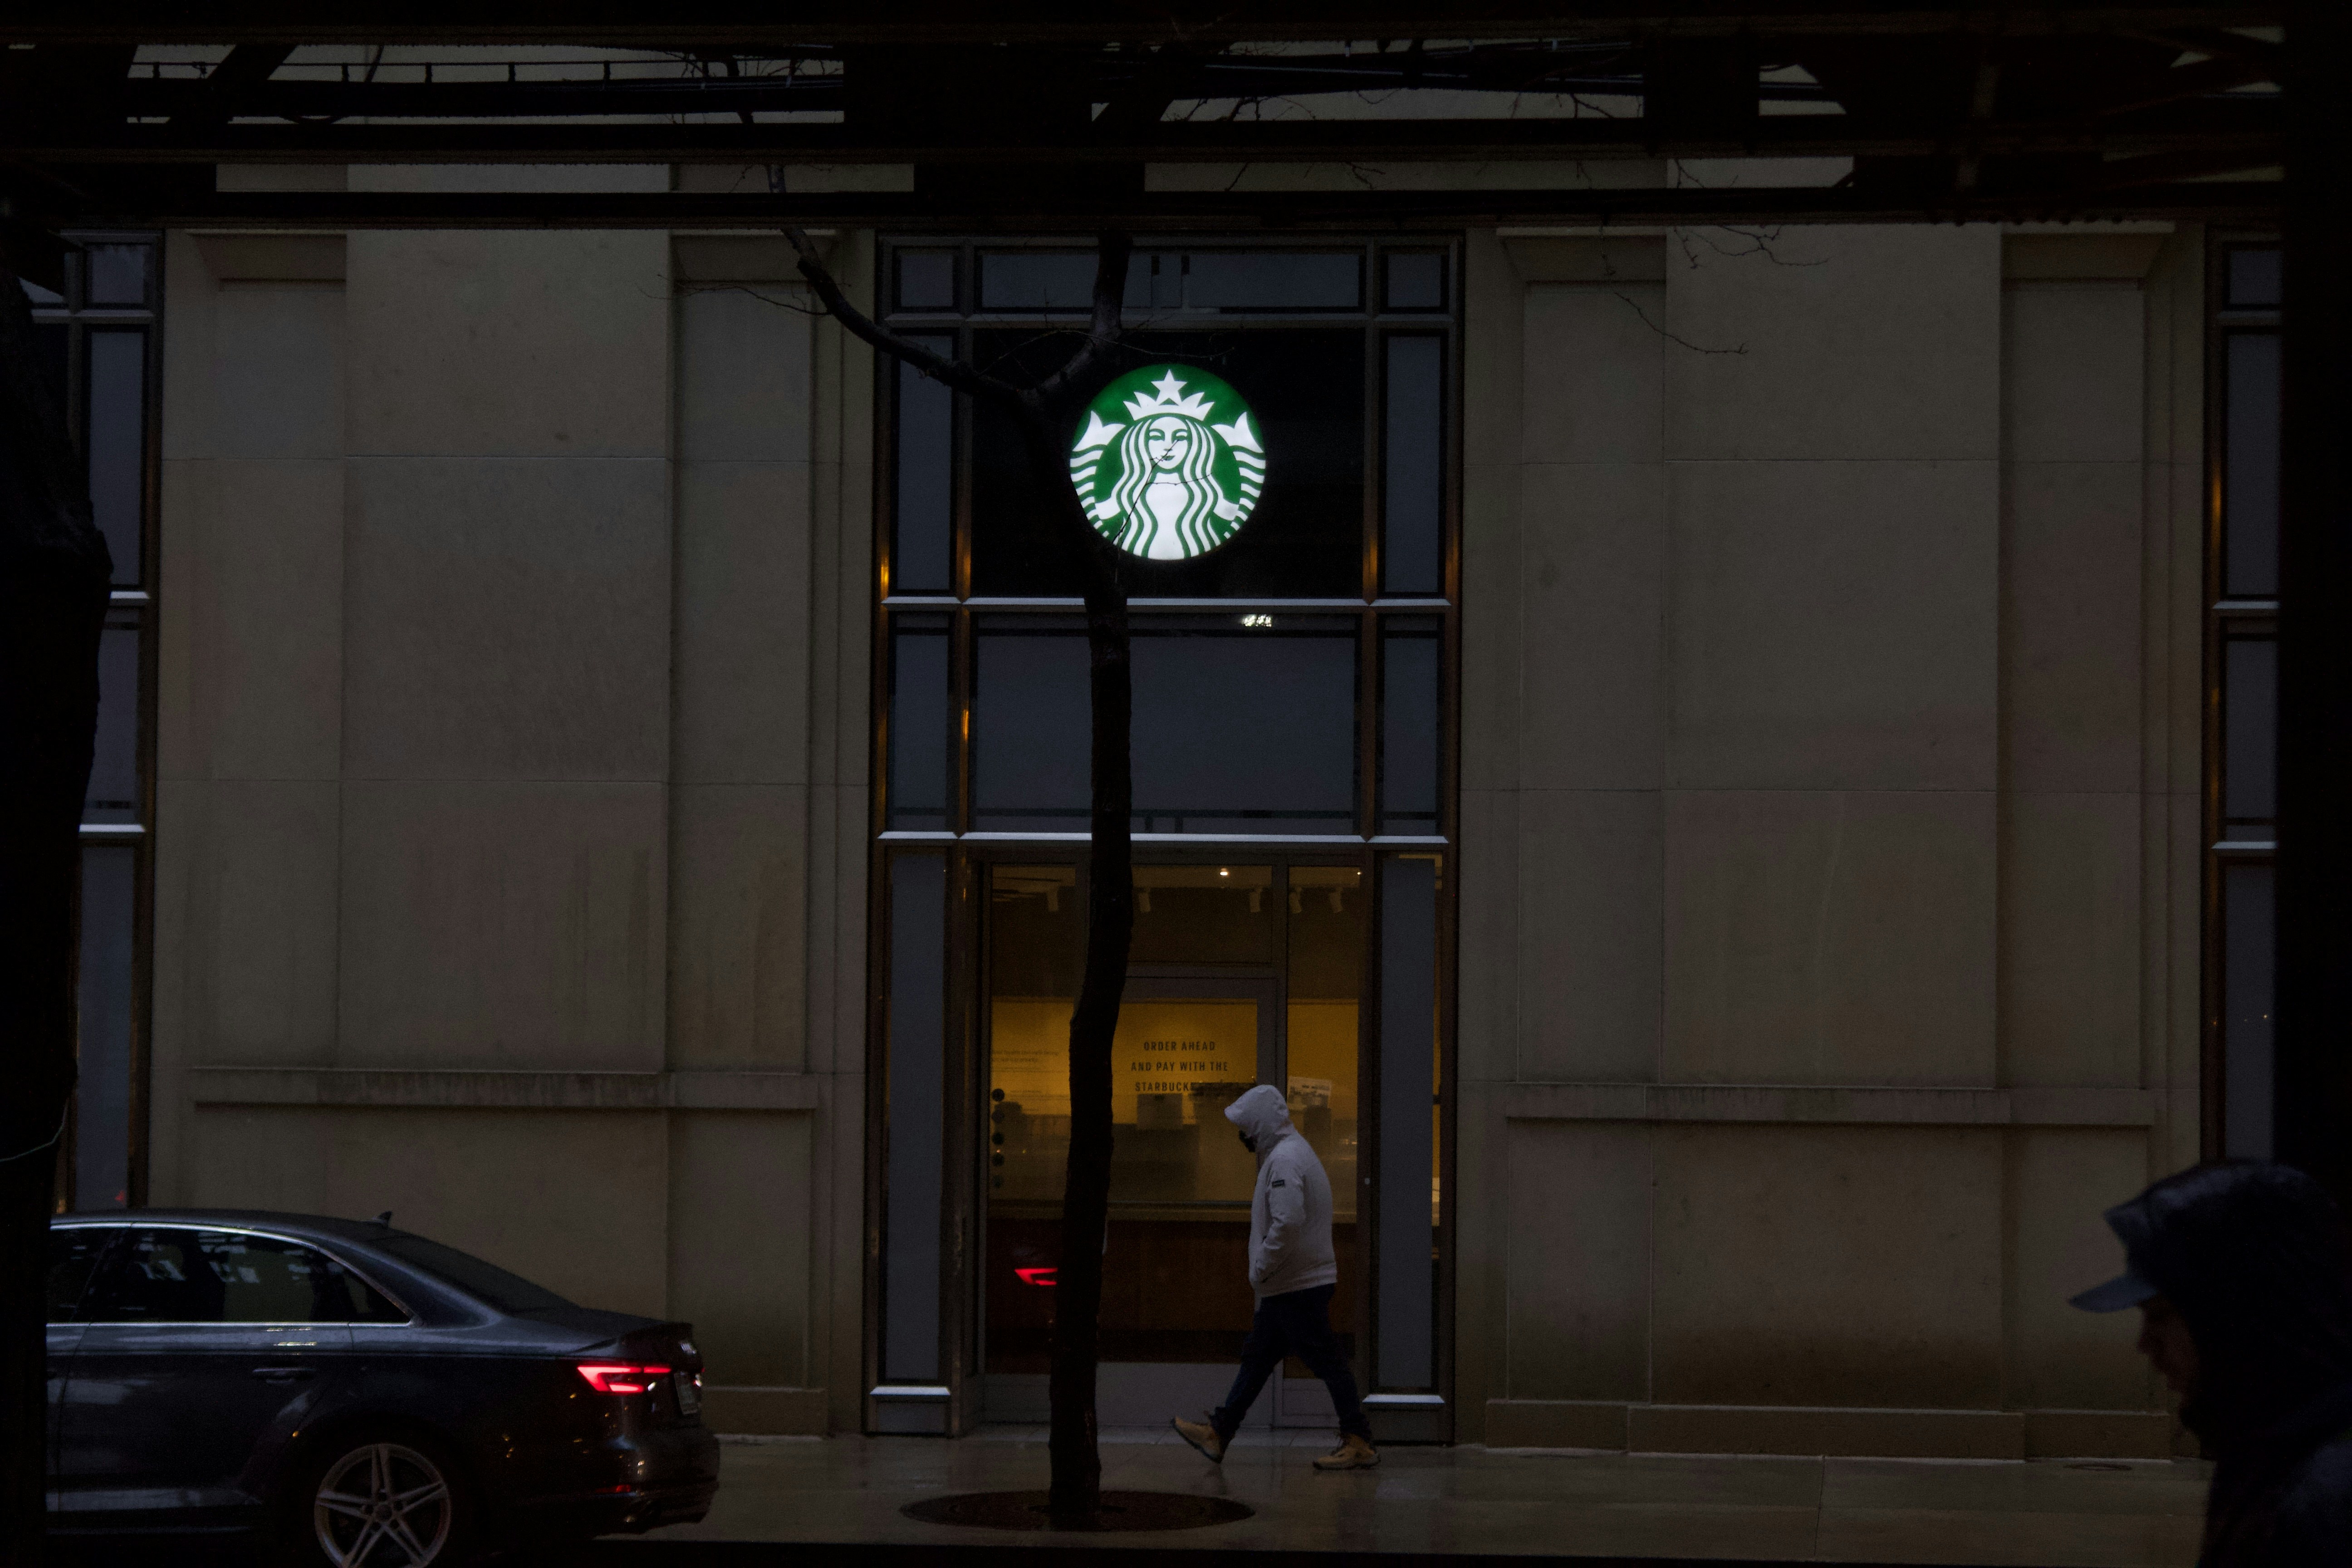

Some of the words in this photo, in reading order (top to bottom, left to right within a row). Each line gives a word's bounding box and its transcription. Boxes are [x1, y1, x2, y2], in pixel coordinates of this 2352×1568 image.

[1143, 1041, 1177, 1051] ORDER
[1181, 1041, 1215, 1051] AHEAD
[1131, 1062, 1152, 1071] AND
[1156, 1062, 1175, 1071] PAY
[1180, 1062, 1205, 1071] WITH
[1210, 1062, 1228, 1071] THE
